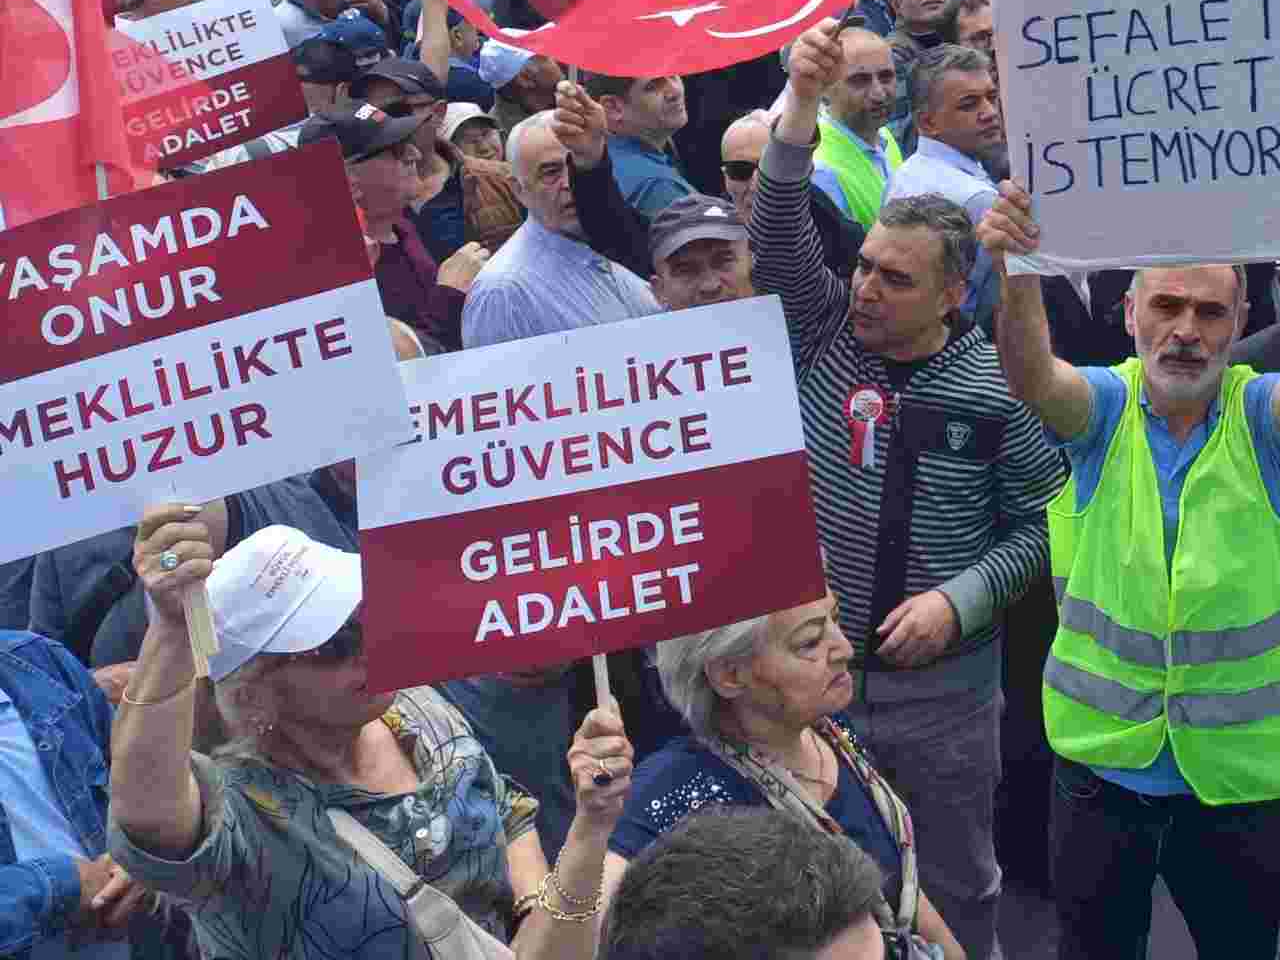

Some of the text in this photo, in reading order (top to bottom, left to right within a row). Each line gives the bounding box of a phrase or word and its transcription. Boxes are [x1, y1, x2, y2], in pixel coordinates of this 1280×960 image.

[127, 81, 252, 137] GELİRDE
[143, 108, 253, 161] ADALET
[0, 193, 272, 302] AŞAMDA
[40, 265, 223, 346] ONUR
[53, 401, 274, 499] HUZUR
[441, 412, 713, 496] GÜVENCE
[459, 501, 704, 582] GELİRDE
[473, 562, 702, 643] ADALET
